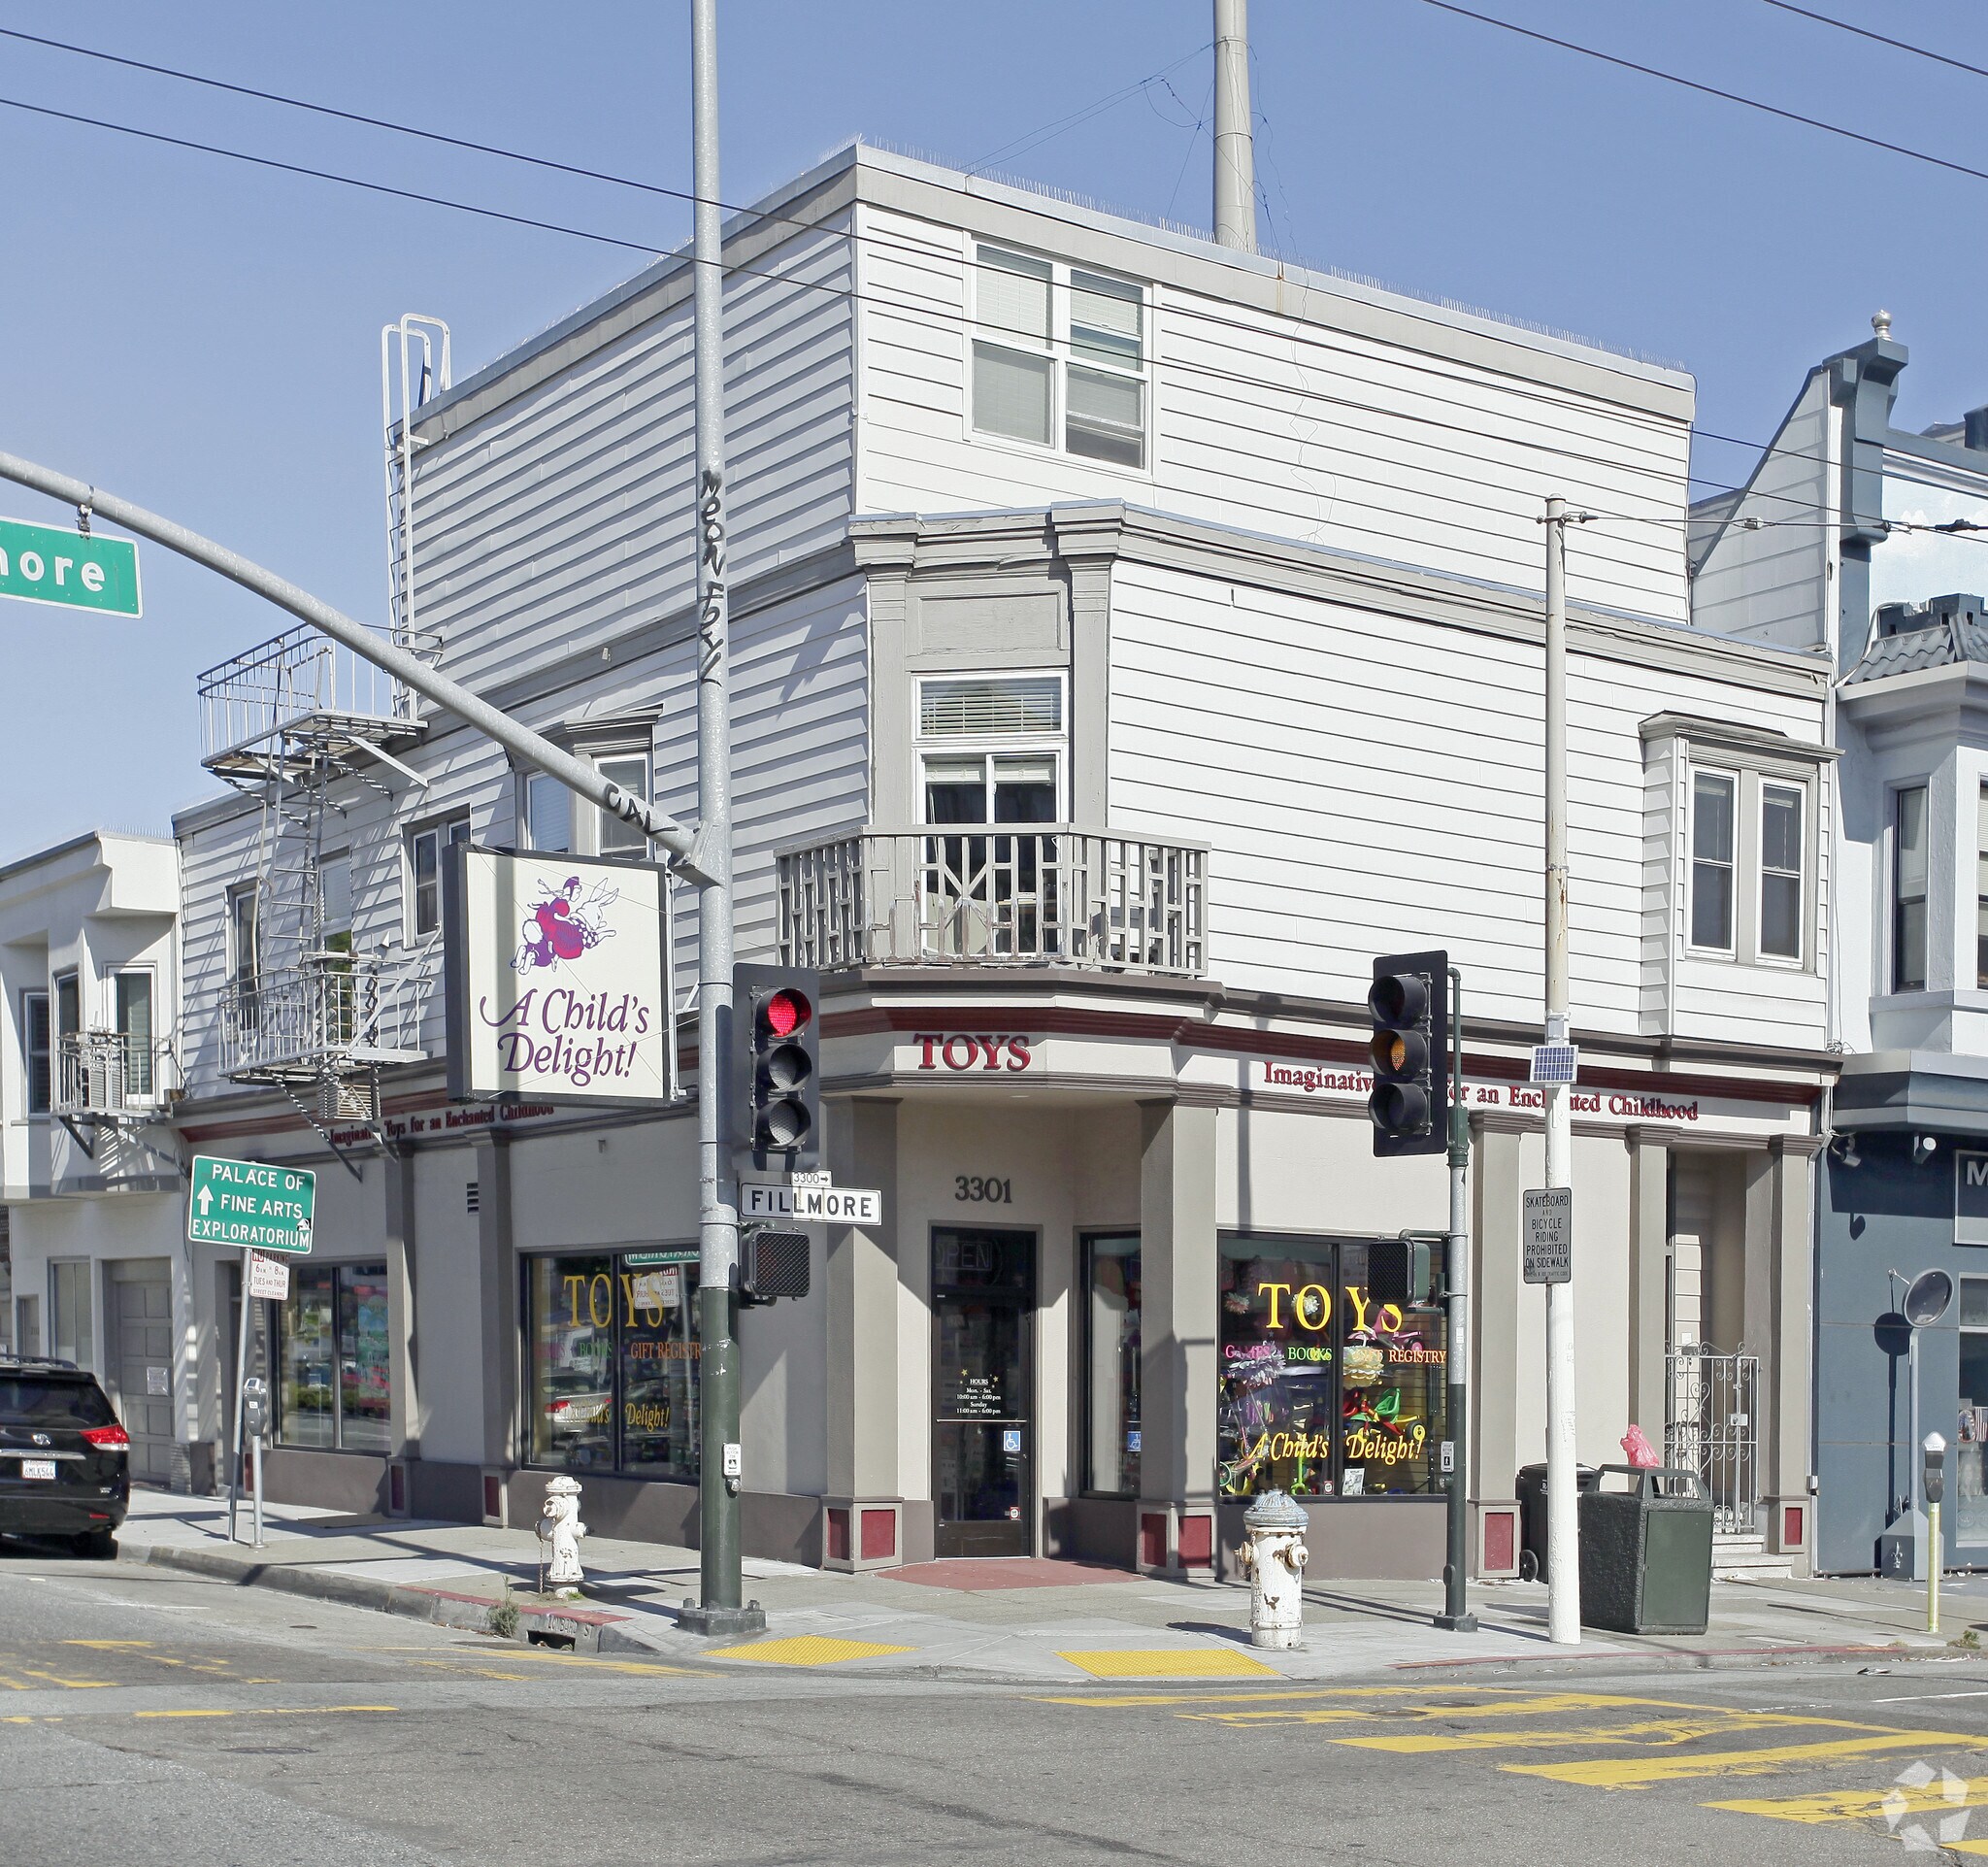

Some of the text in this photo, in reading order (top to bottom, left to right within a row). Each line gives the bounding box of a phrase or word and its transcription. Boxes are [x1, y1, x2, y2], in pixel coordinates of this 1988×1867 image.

[0, 546, 106, 591] ore
[480, 988, 649, 1034] A Child's
[497, 1032, 637, 1086] Delight!
[913, 1033, 1031, 1072] TOYS
[1264, 1060, 1375, 1093] Imaginativ
[1477, 1087, 1500, 1104] an
[1608, 1094, 1698, 1121] Childhood
[384, 1119, 406, 1140] Toys
[411, 1116, 424, 1133] for
[430, 1117, 442, 1130] an
[446, 1105, 495, 1128] Enchanted
[212, 1164, 306, 1191] PALACE OF
[793, 1171, 819, 1184] 3300
[954, 1176, 1012, 1204] 3301
[220, 1193, 303, 1219] FINE ARTS
[751, 1189, 872, 1217] FILLMORE
[1526, 1195, 1569, 1208] SKATEBOARD
[192, 1218, 310, 1249] EXPLORATORIUM
[1532, 1217, 1562, 1229] BICYCLE
[1535, 1231, 1559, 1243] RIDING
[1525, 1256, 1569, 1269] ON SIDEWALK
[1526, 1244, 1568, 1255] PROHIBITED
[253, 1277, 265, 1285] TUES
[274, 1279, 286, 1288] THUR
[563, 1273, 663, 1328] TOYS
[631, 1342, 654, 1359] GIFT
[657, 1342, 701, 1359] REGISTR
[1288, 1347, 1332, 1361] BOOKS
[1388, 1349, 1446, 1363] REGISTRY
[624, 1403, 670, 1432] Delight!
[1271, 1432, 1329, 1461] Child's
[1345, 1434, 1424, 1466] Delight!
